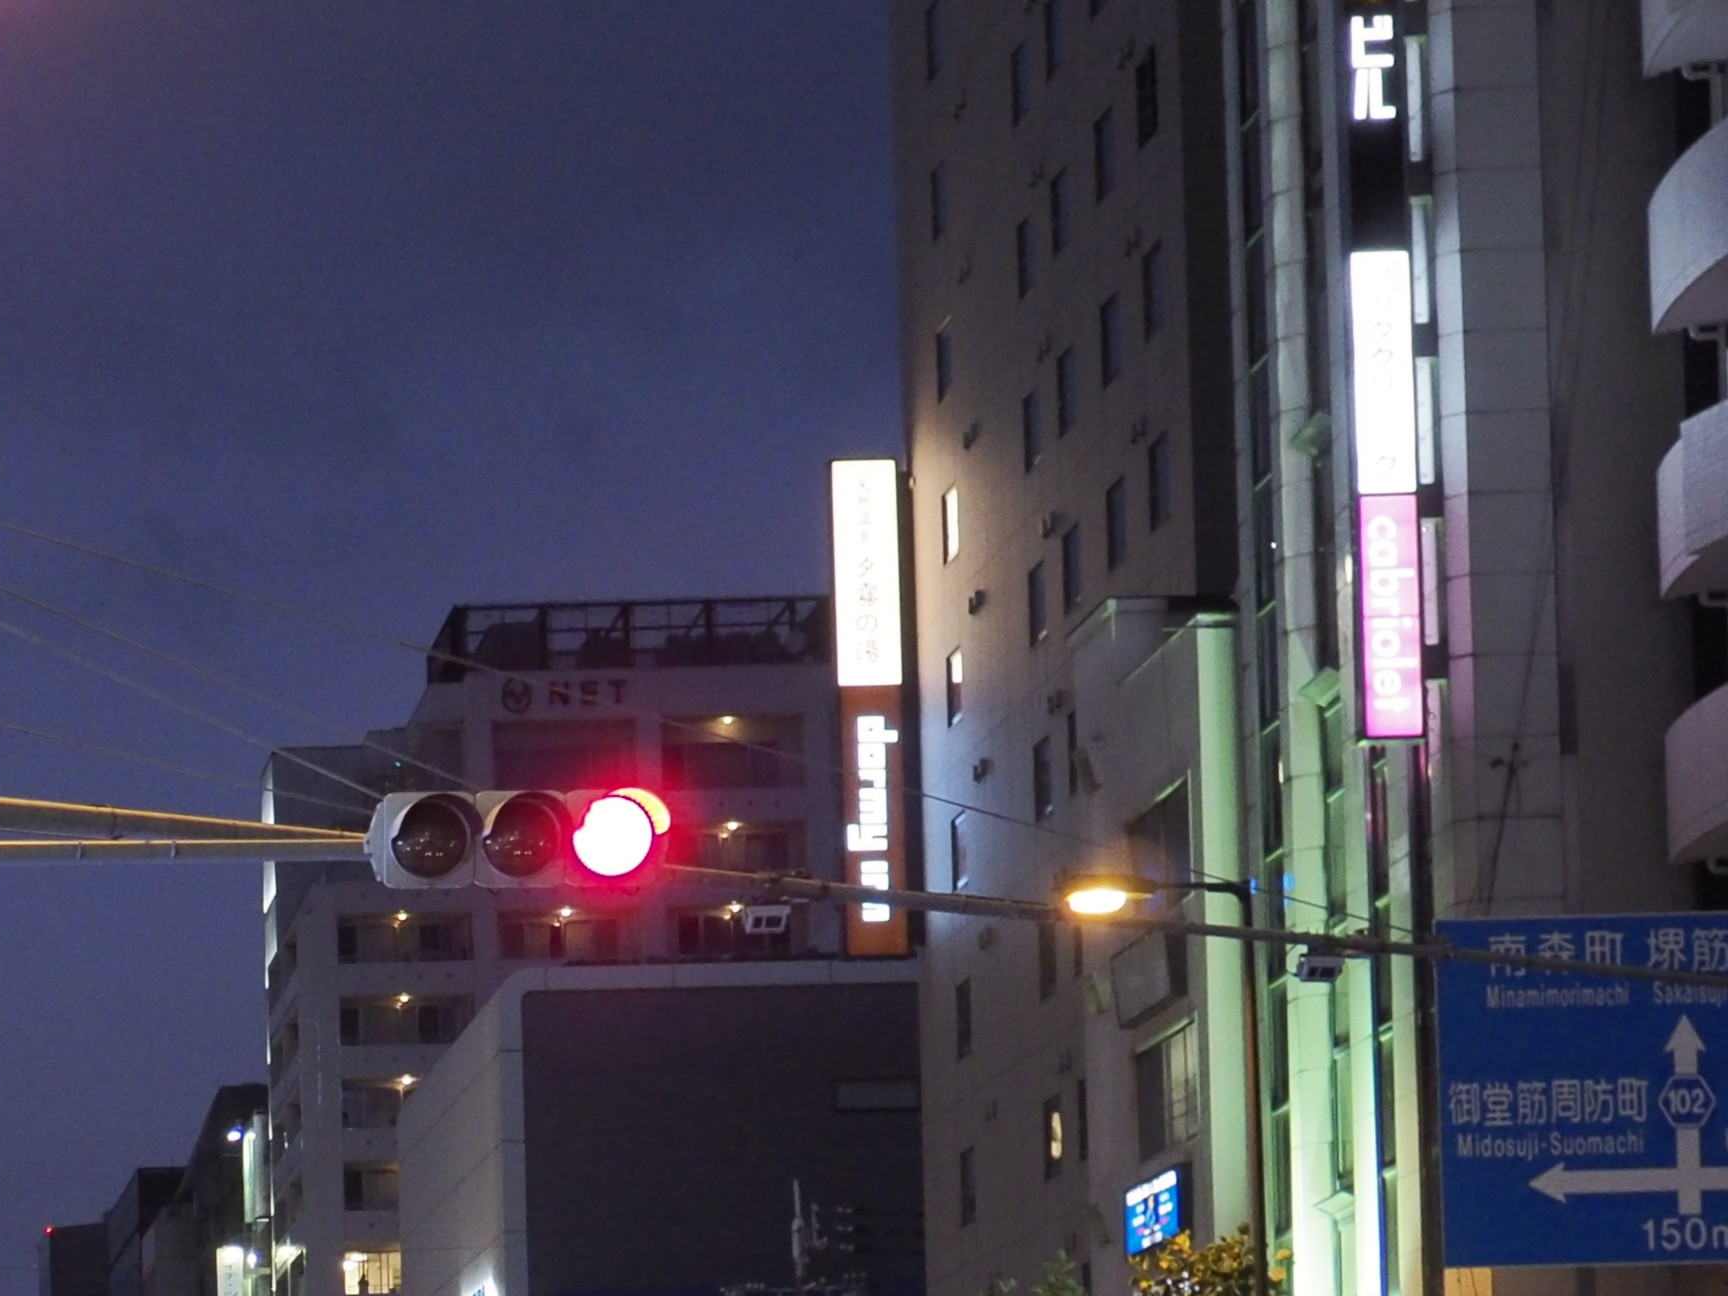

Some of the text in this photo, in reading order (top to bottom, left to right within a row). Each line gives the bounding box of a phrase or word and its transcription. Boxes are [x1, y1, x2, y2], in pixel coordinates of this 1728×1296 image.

[1350, 15, 1397, 120] ビル
[1367, 516, 1418, 712] cabriolet
[847, 715, 899, 852] dormy
[1488, 931, 1624, 978] 南森町
[1449, 1078, 1648, 1127] 御堂筋周防町
[1667, 1088, 1705, 1115] 102
[1457, 1131, 1644, 1160] Midosuji-Suomachi
